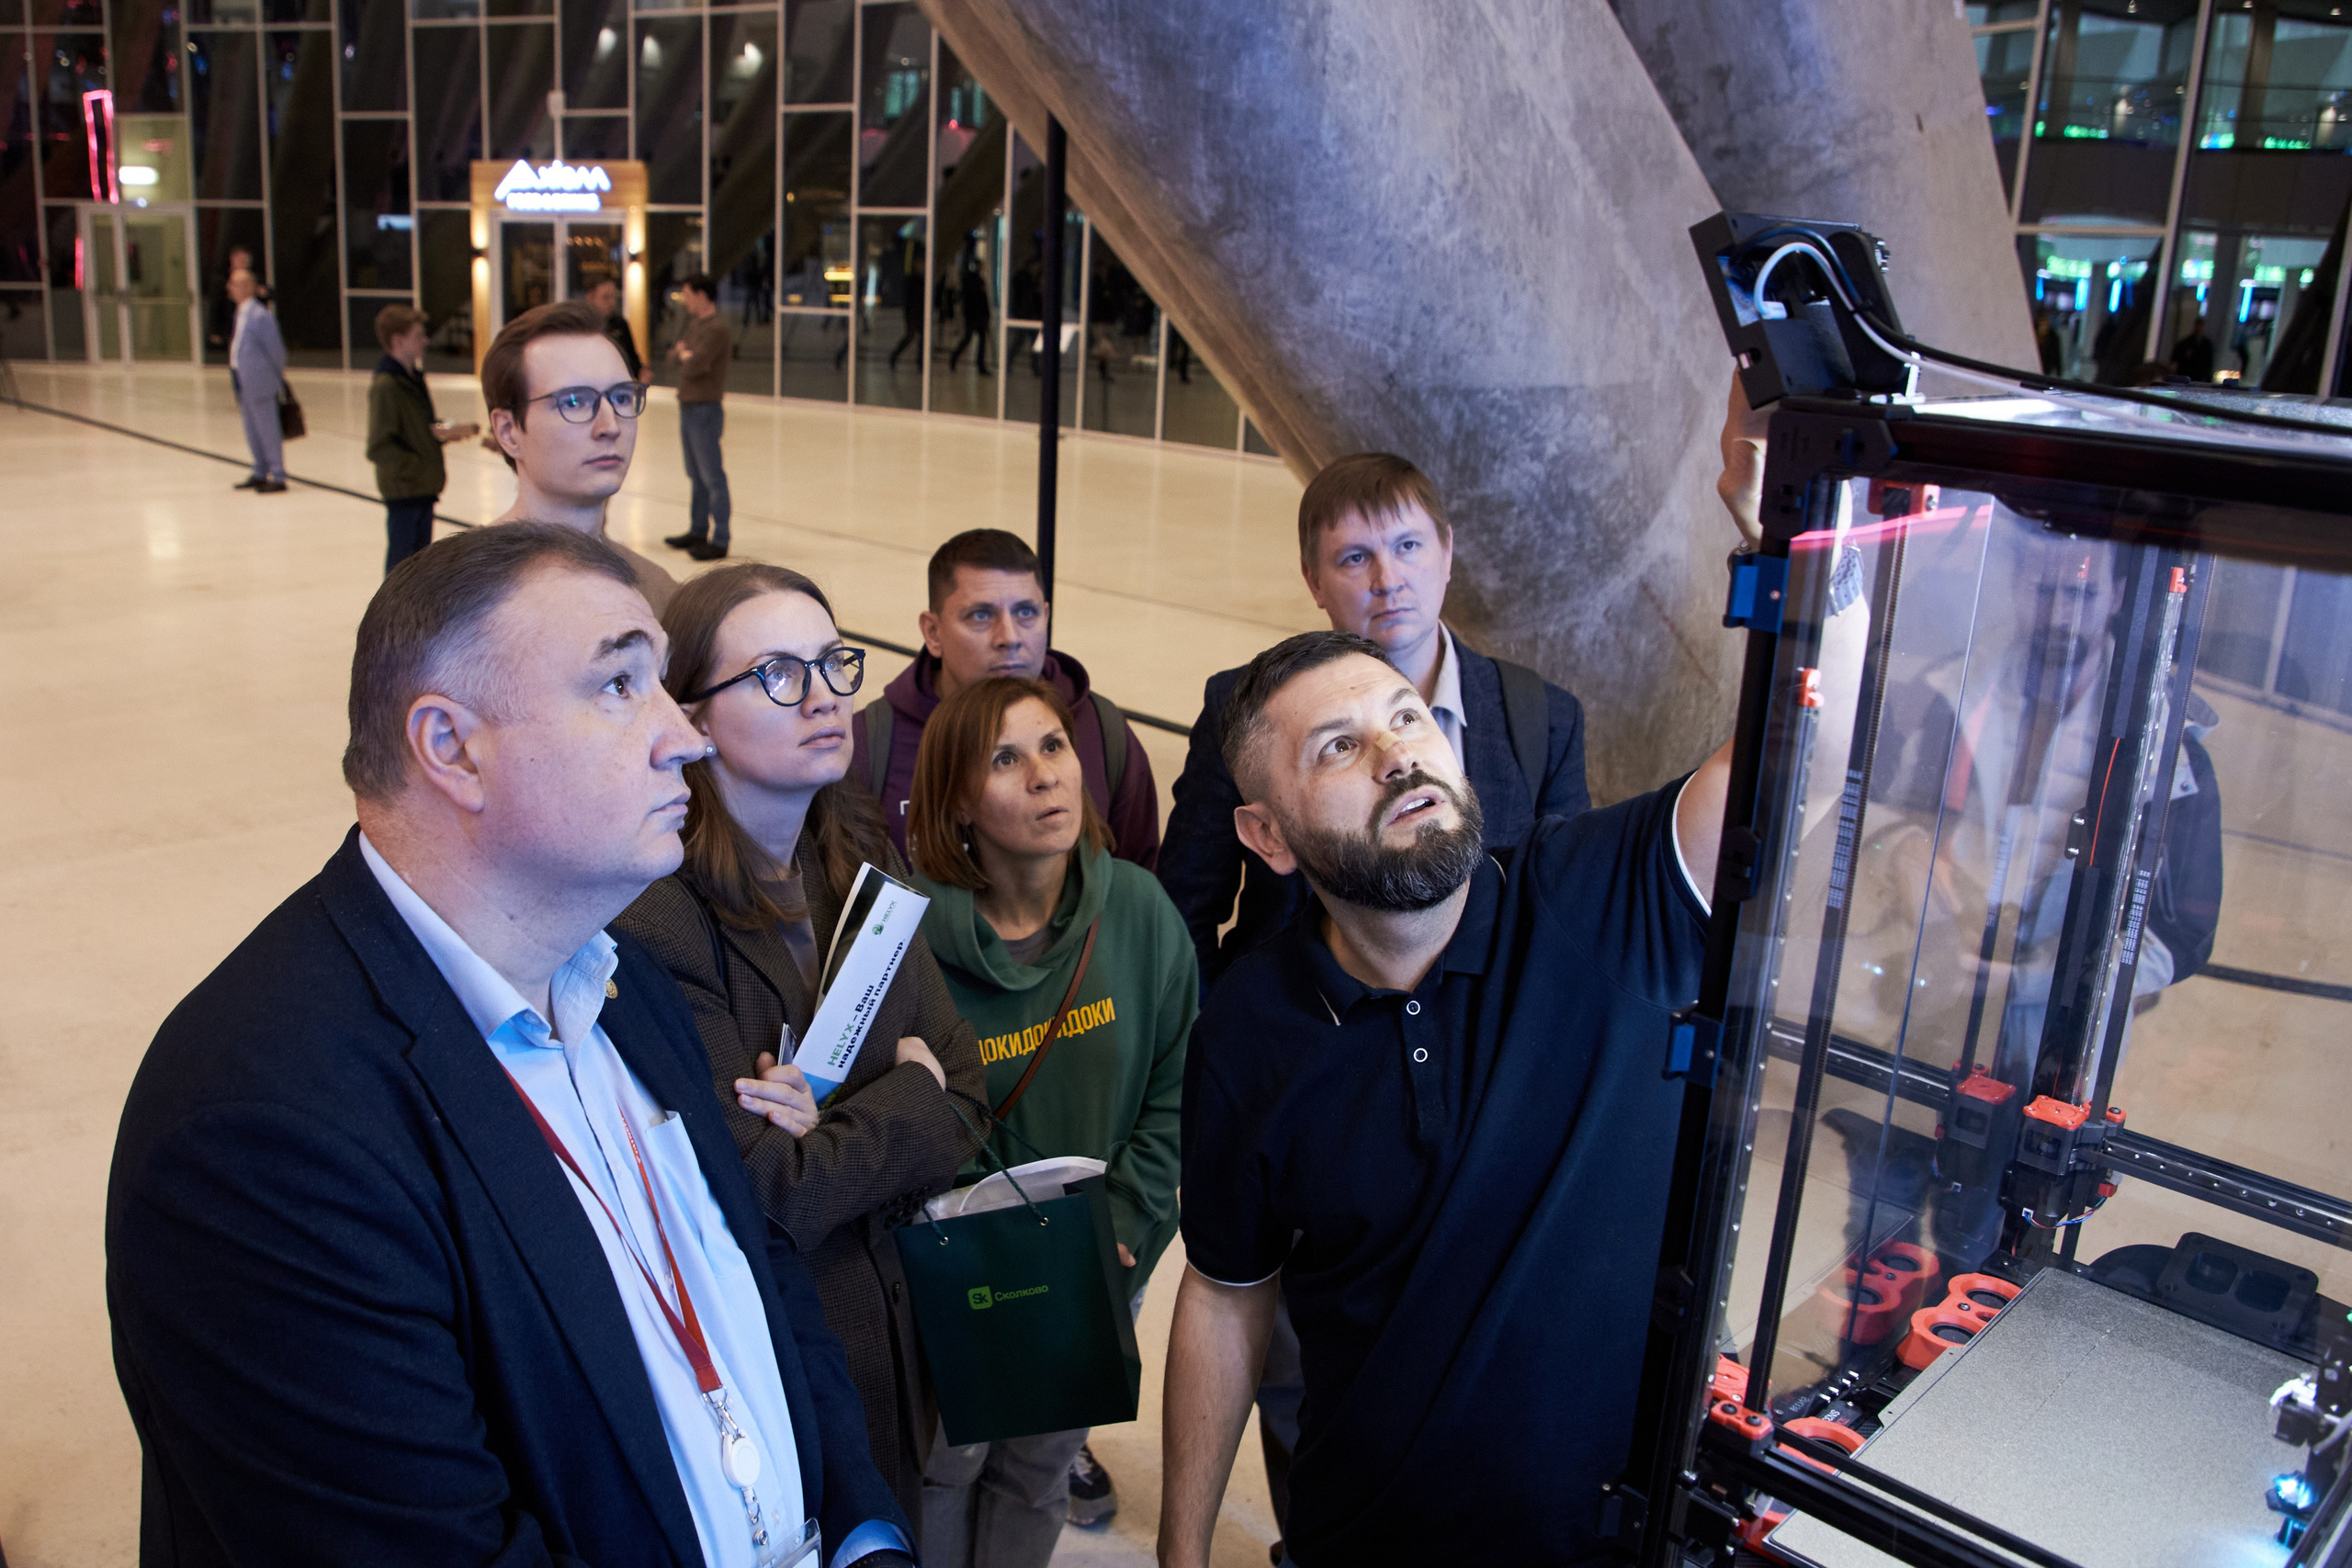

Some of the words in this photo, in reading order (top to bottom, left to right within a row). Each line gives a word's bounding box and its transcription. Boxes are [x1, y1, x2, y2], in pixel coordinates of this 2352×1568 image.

[827, 1023, 854, 1066] HELYX
[854, 985, 875, 1013] Ваш
[838, 994, 876, 1068] надежный
[994, 1285, 1048, 1301] Сколково
